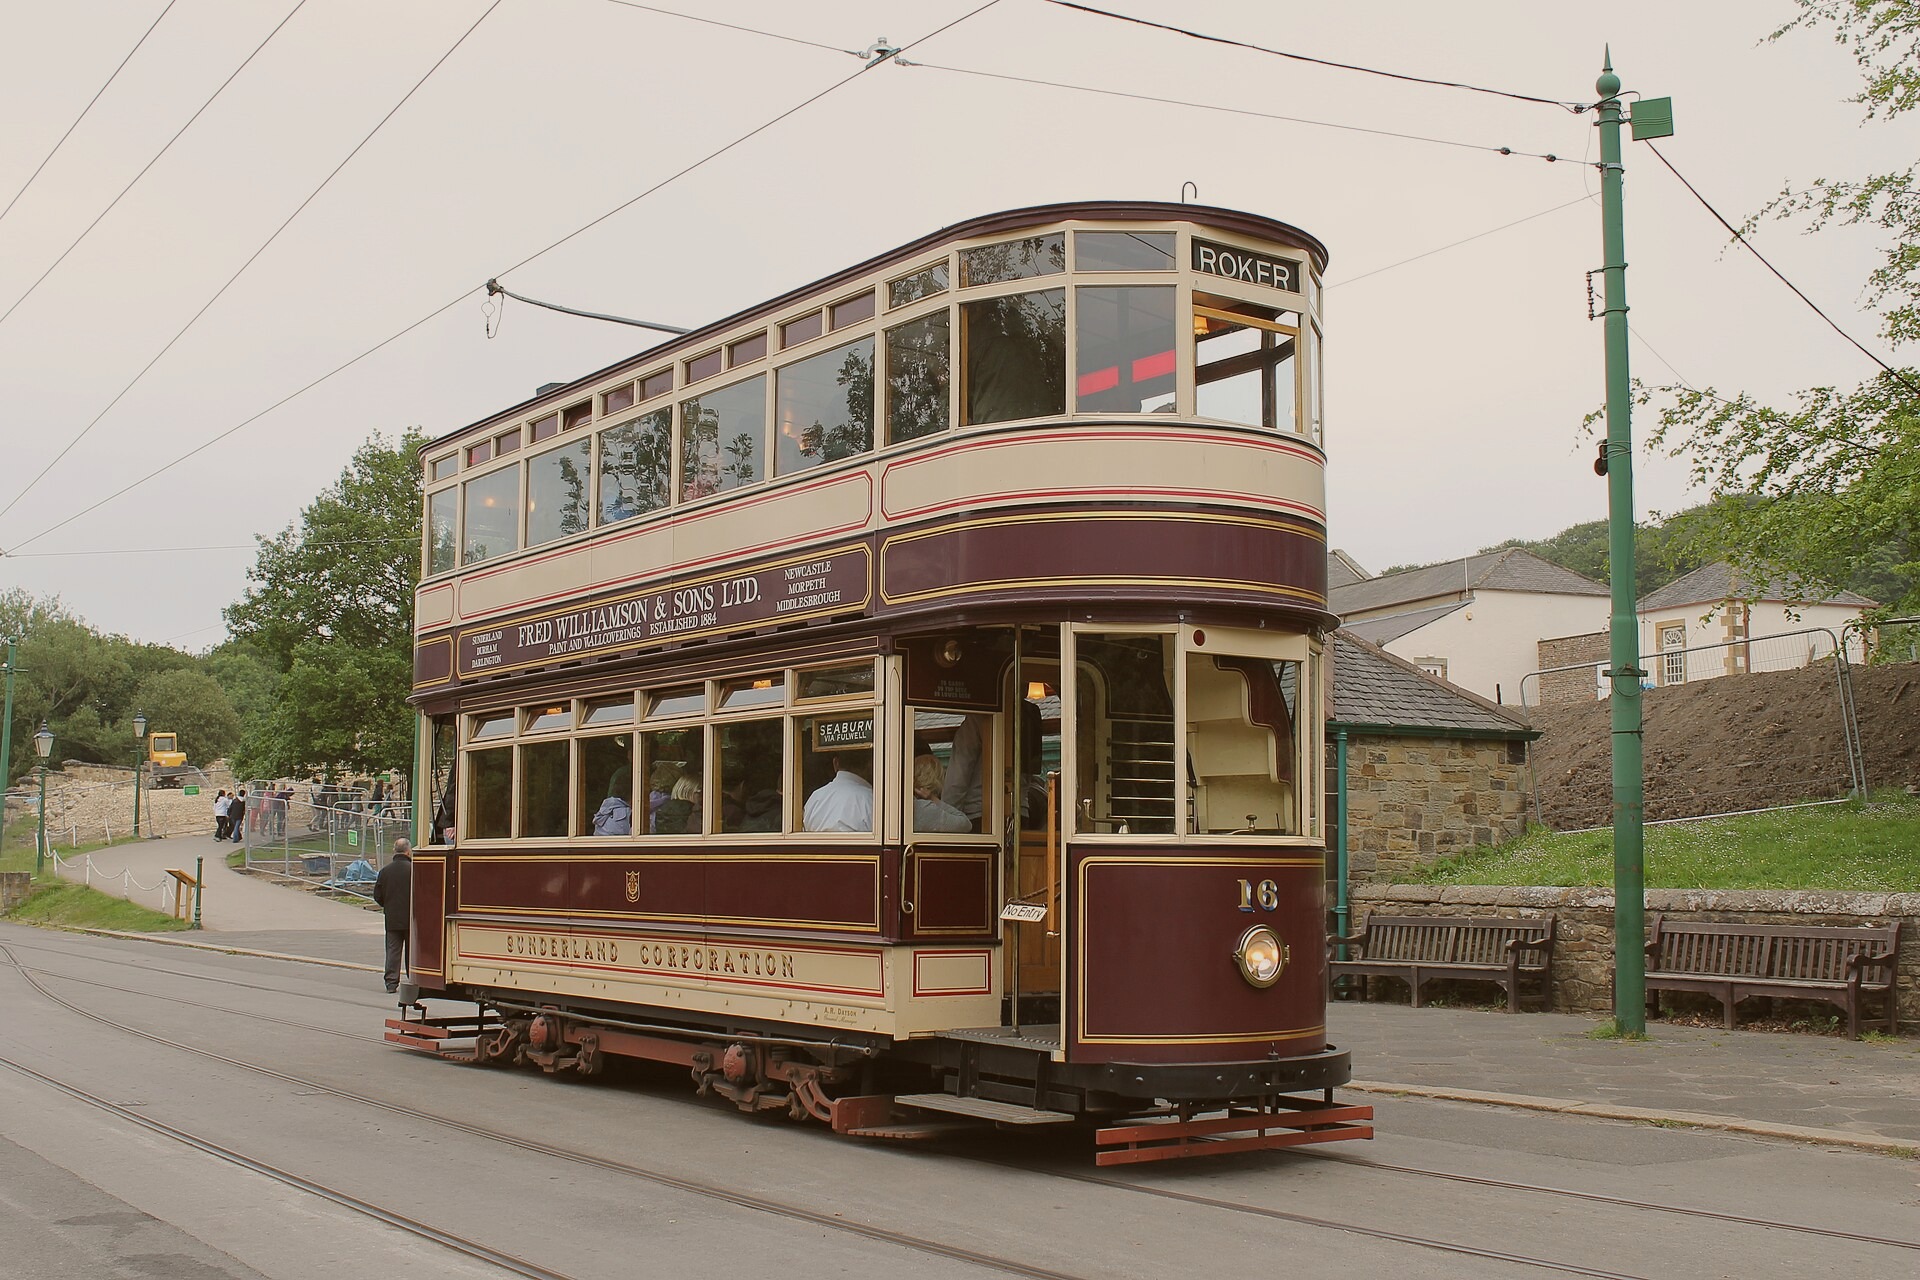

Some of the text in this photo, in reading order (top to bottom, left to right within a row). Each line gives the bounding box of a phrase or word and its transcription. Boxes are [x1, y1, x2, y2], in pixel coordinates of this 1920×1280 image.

[1200, 246, 1290, 290] ROKER
[784, 561, 832, 580] NEWCASTLE
[788, 578, 826, 595] MORPETH
[776, 590, 841, 612] MIDDLESBROUGH
[517, 577, 761, 648] FRED WILLIAMSON & SONS LTD.
[472, 630, 503, 646] SUNDERLAND
[549, 641, 568, 655] PAINT
[568, 638, 582, 651] AND
[583, 626, 641, 649] WALLCOVERINGS
[700, 612, 717, 626] 1884
[476, 643, 498, 656] DURHAM
[471, 655, 502, 669] DARLINGTON
[820, 720, 873, 736] SEABURN
[824, 731, 867, 742] VIA FULWELL
[1237, 879, 1278, 912] 16
[1004, 905, 1044, 920] No Entry
[507, 935, 794, 978] SUNDERLAND CORPORATION
